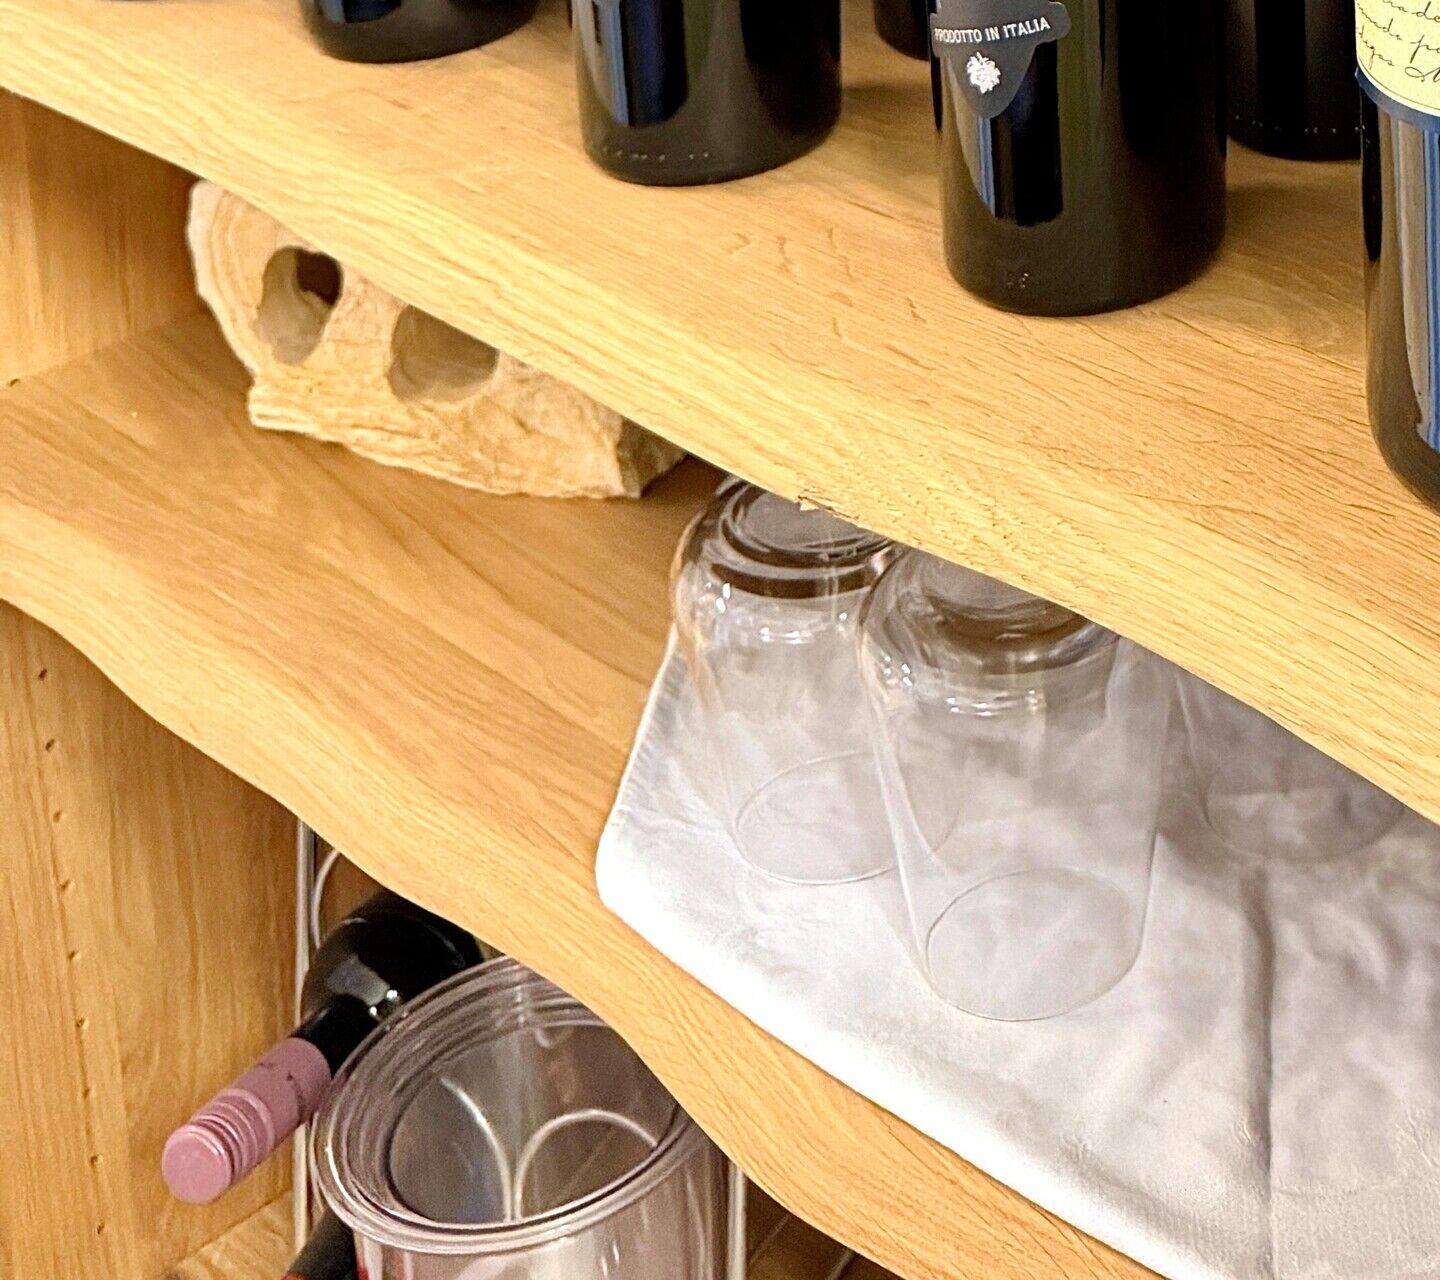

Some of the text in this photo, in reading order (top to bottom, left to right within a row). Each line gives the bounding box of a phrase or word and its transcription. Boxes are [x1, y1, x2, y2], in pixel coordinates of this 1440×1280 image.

[934, 16, 1051, 44] PRODOTTO IN ITALIA
